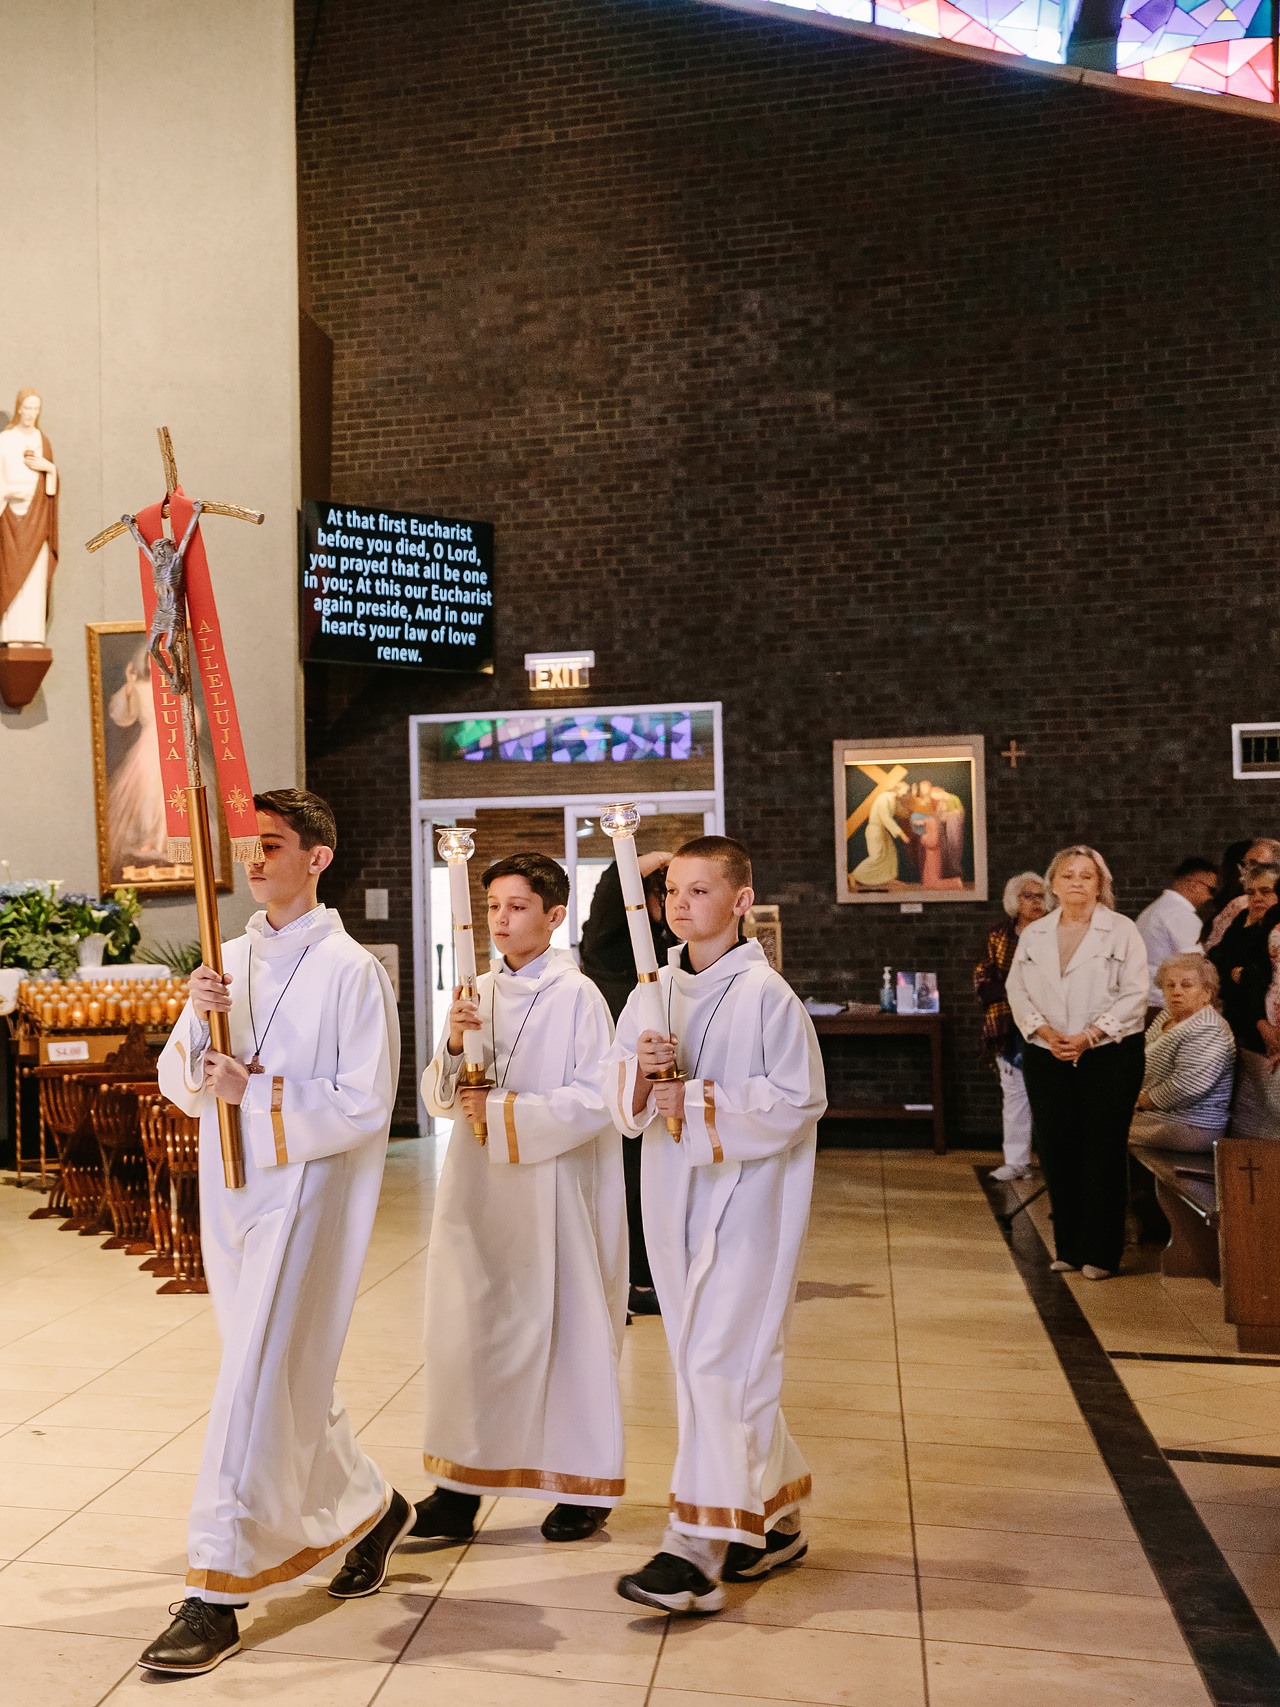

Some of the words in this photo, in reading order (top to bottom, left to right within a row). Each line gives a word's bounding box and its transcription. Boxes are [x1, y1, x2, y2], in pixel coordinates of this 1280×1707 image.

[327, 508, 343, 527] At
[346, 510, 375, 531] that
[378, 513, 407, 535] first
[410, 518, 473, 543] Eucharist
[317, 527, 363, 551] before
[366, 537, 392, 556] you
[395, 537, 430, 561] died,
[433, 542, 444, 560] O
[447, 544, 481, 567] Lord,
[309, 553, 336, 571] you
[340, 556, 388, 577] prayed
[391, 558, 420, 578] that
[423, 561, 440, 580] all
[443, 563, 460, 582] be
[463, 570, 488, 585] one
[304, 570, 318, 589] in
[321, 576, 353, 595] you;
[356, 576, 372, 595] At
[375, 577, 402, 598] this
[404, 584, 428, 600] our
[431, 584, 493, 607] Eucharist
[313, 595, 353, 617] again
[356, 600, 412, 622] preside,
[415, 603, 442, 623] And
[445, 605, 458, 624] in
[461, 611, 484, 626] our
[321, 615, 367, 637] hearts
[369, 623, 401, 642] your
[404, 622, 428, 642] law
[431, 625, 446, 643] of
[448, 626, 477, 646] love
[377, 645, 422, 663] renew.
[197, 619, 236, 761] ALLELUJA
[536, 662, 583, 689] EXIT
